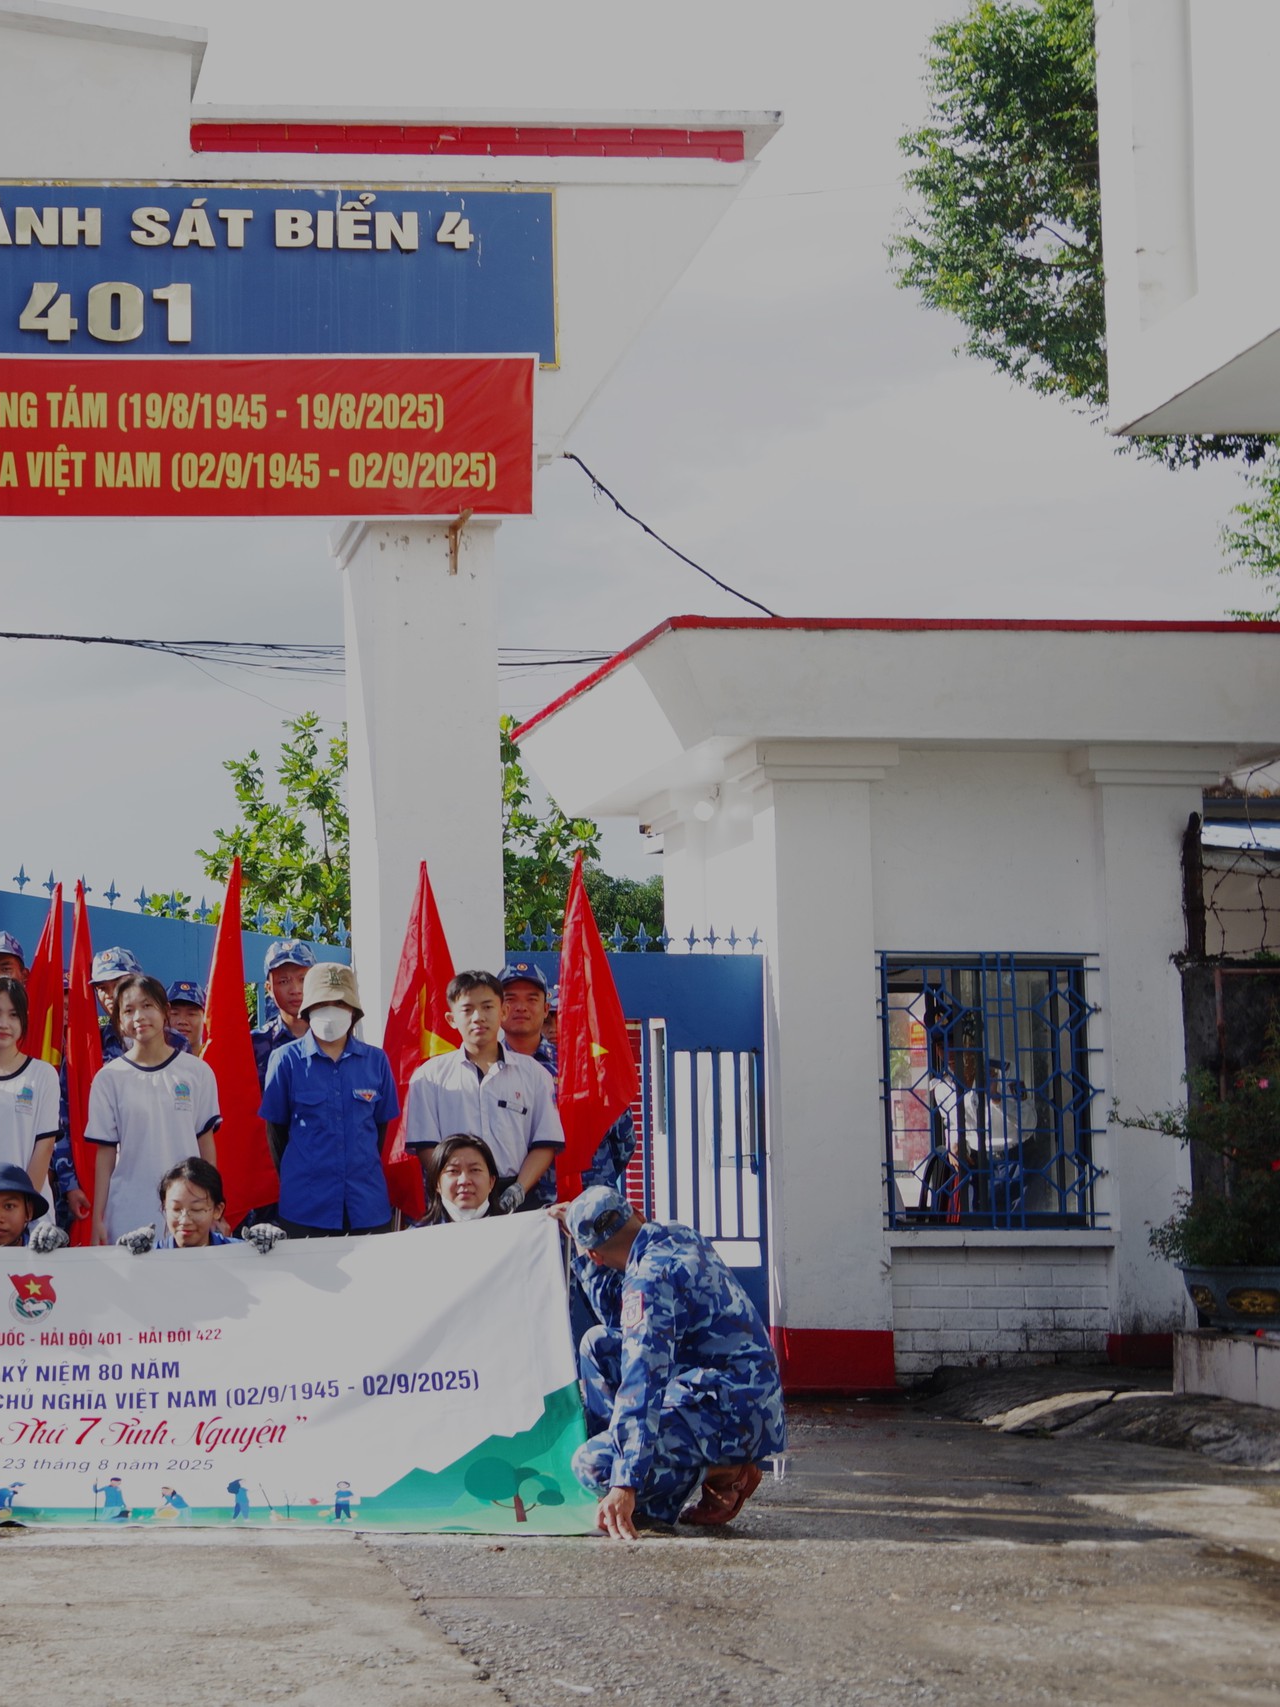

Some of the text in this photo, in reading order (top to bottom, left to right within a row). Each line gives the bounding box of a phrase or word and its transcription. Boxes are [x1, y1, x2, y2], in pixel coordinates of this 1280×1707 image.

[131, 198, 253, 246] SÁT
[276, 192, 418, 249] BIỂN
[436, 211, 474, 248] 4
[20, 282, 191, 341] 401
[46, 385, 107, 428] TÁM
[118, 393, 267, 432] (19/8/1945
[297, 393, 444, 432] 19/8/2025)
[27, 444, 86, 495] VIỆT
[95, 452, 160, 487] NAM
[172, 452, 320, 491] (02/9/1945
[349, 452, 496, 490] 02/9/2025)
[40, 1328, 64, 1345] HẢI
[68, 1329, 93, 1349] ĐỘI
[98, 1332, 122, 1345] 401
[138, 1326, 162, 1344] HẢI
[166, 1327, 191, 1343] ĐỘI
[196, 1329, 221, 1341] 422
[2, 1359, 28, 1382] KỶ
[36, 1362, 89, 1385] NIỆM
[99, 1364, 122, 1380] 80
[132, 1359, 179, 1379] NĂM
[42, 1389, 107, 1410] NGHĨA
[116, 1389, 159, 1413] VIỆT
[168, 1390, 216, 1408] NAM
[227, 1380, 339, 1408] (02/9/1945
[363, 1369, 479, 1396] 02/9/2025)
[3, 1459, 25, 1469] 23
[34, 1459, 90, 1473] tháng
[98, 1460, 108, 1470] 8
[117, 1458, 159, 1470] năm
[167, 1460, 212, 1470] 2025
